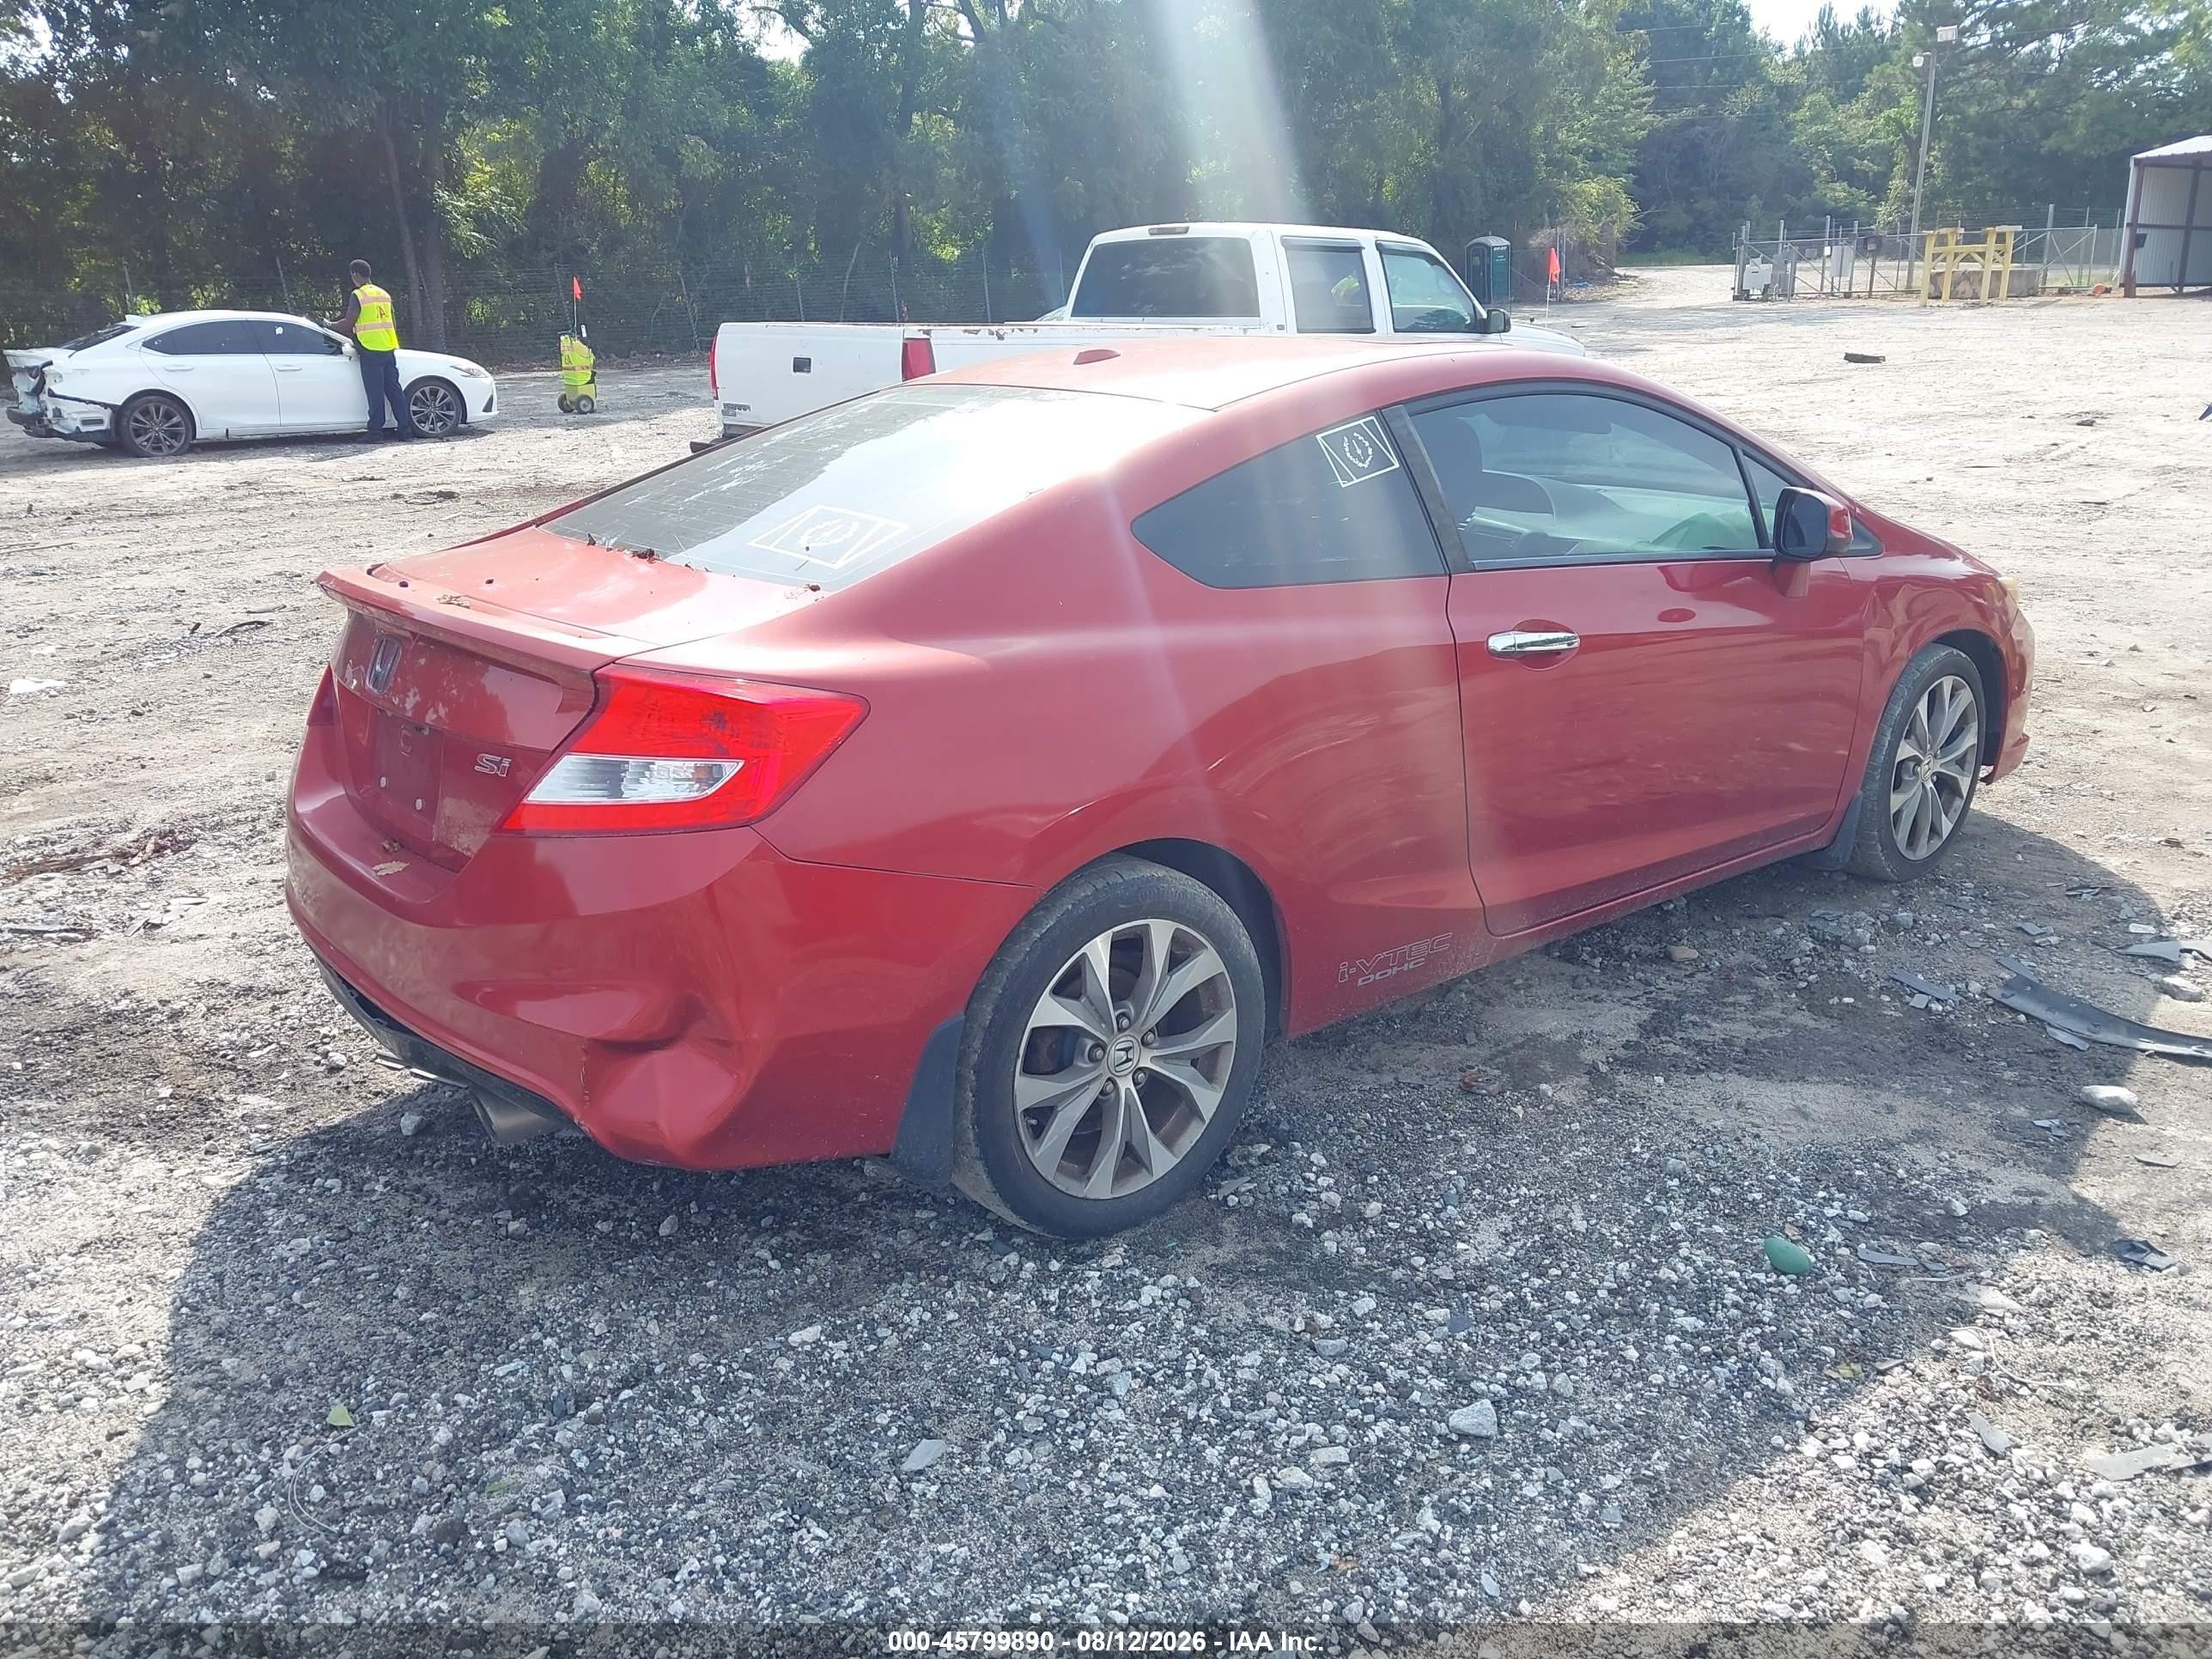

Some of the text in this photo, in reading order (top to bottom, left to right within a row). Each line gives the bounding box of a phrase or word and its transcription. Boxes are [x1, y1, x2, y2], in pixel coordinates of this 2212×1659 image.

[474, 753, 512, 777] Si
[1339, 932, 1453, 983] i-VTEC
[1358, 958, 1425, 987] DOHC
